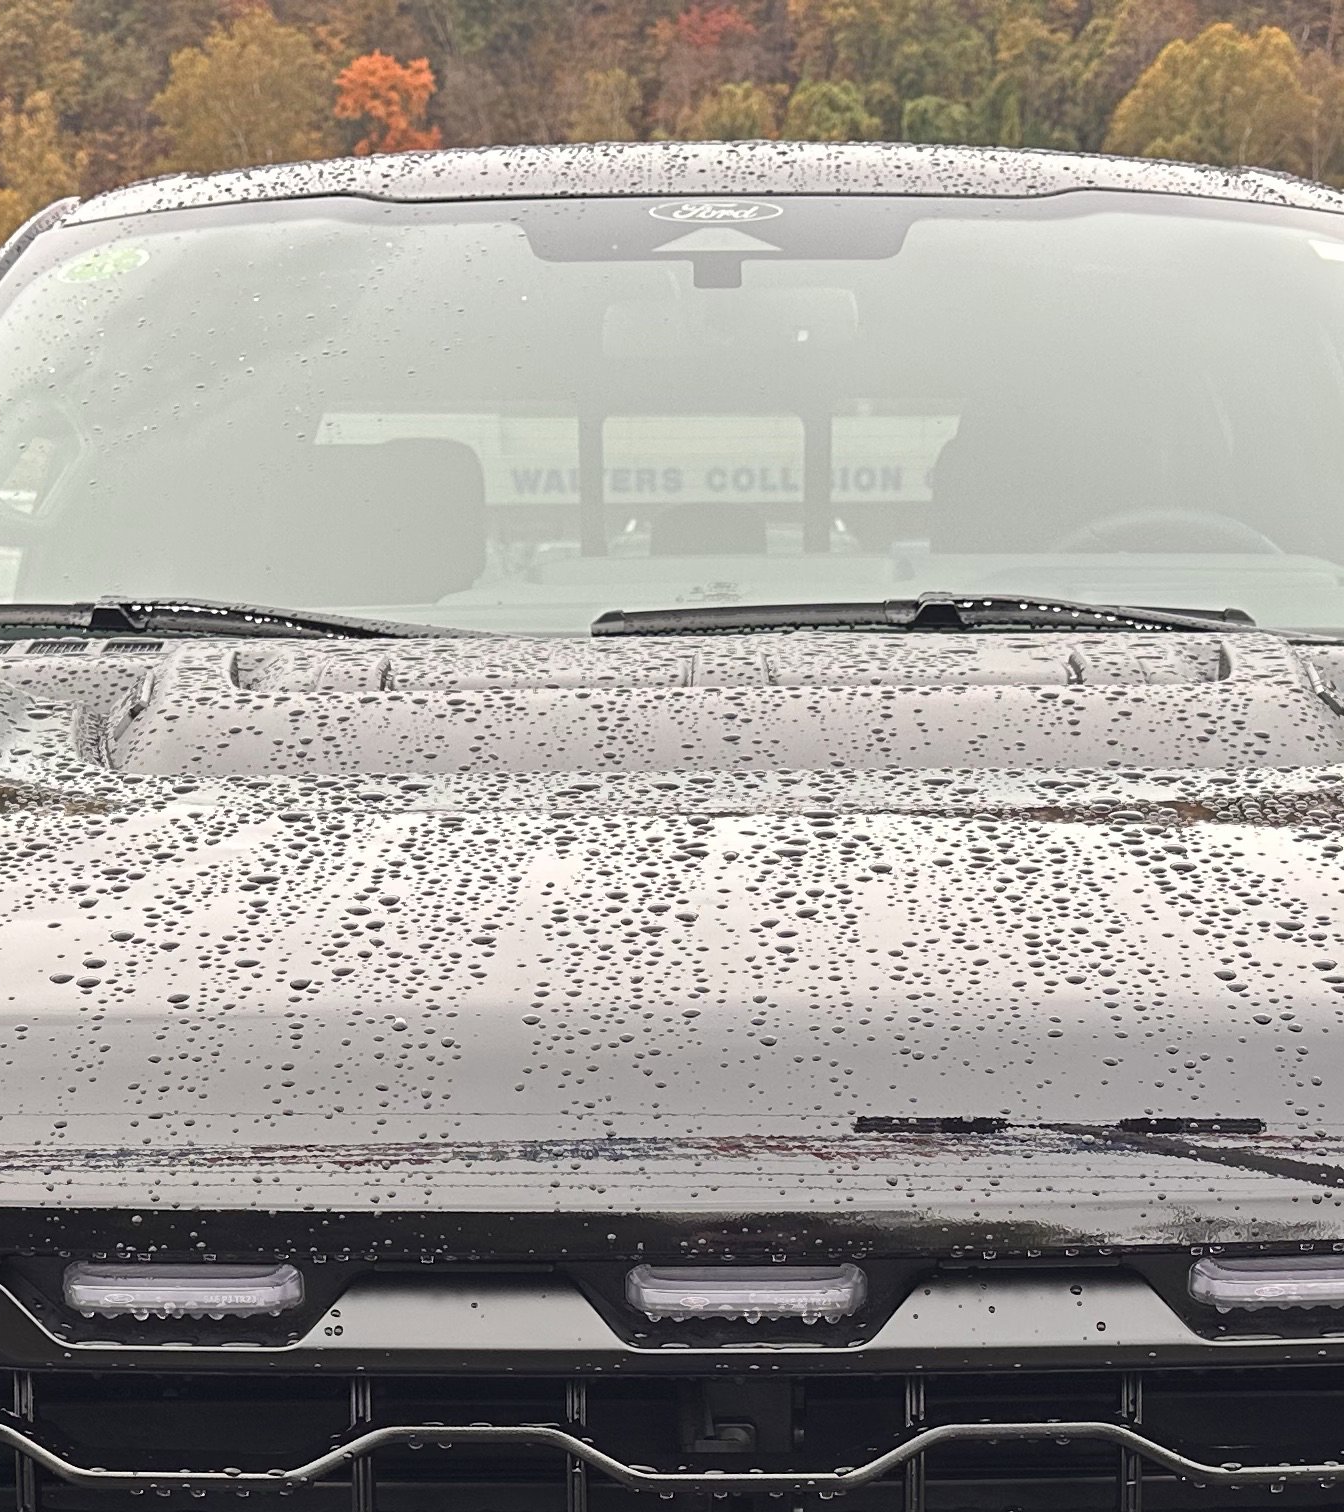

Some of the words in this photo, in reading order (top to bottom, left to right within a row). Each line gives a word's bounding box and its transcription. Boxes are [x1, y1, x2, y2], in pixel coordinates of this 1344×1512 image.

[672, 201, 760, 221] Ford
[511, 467, 684, 495] WAERS
[705, 466, 904, 493] COLLION
